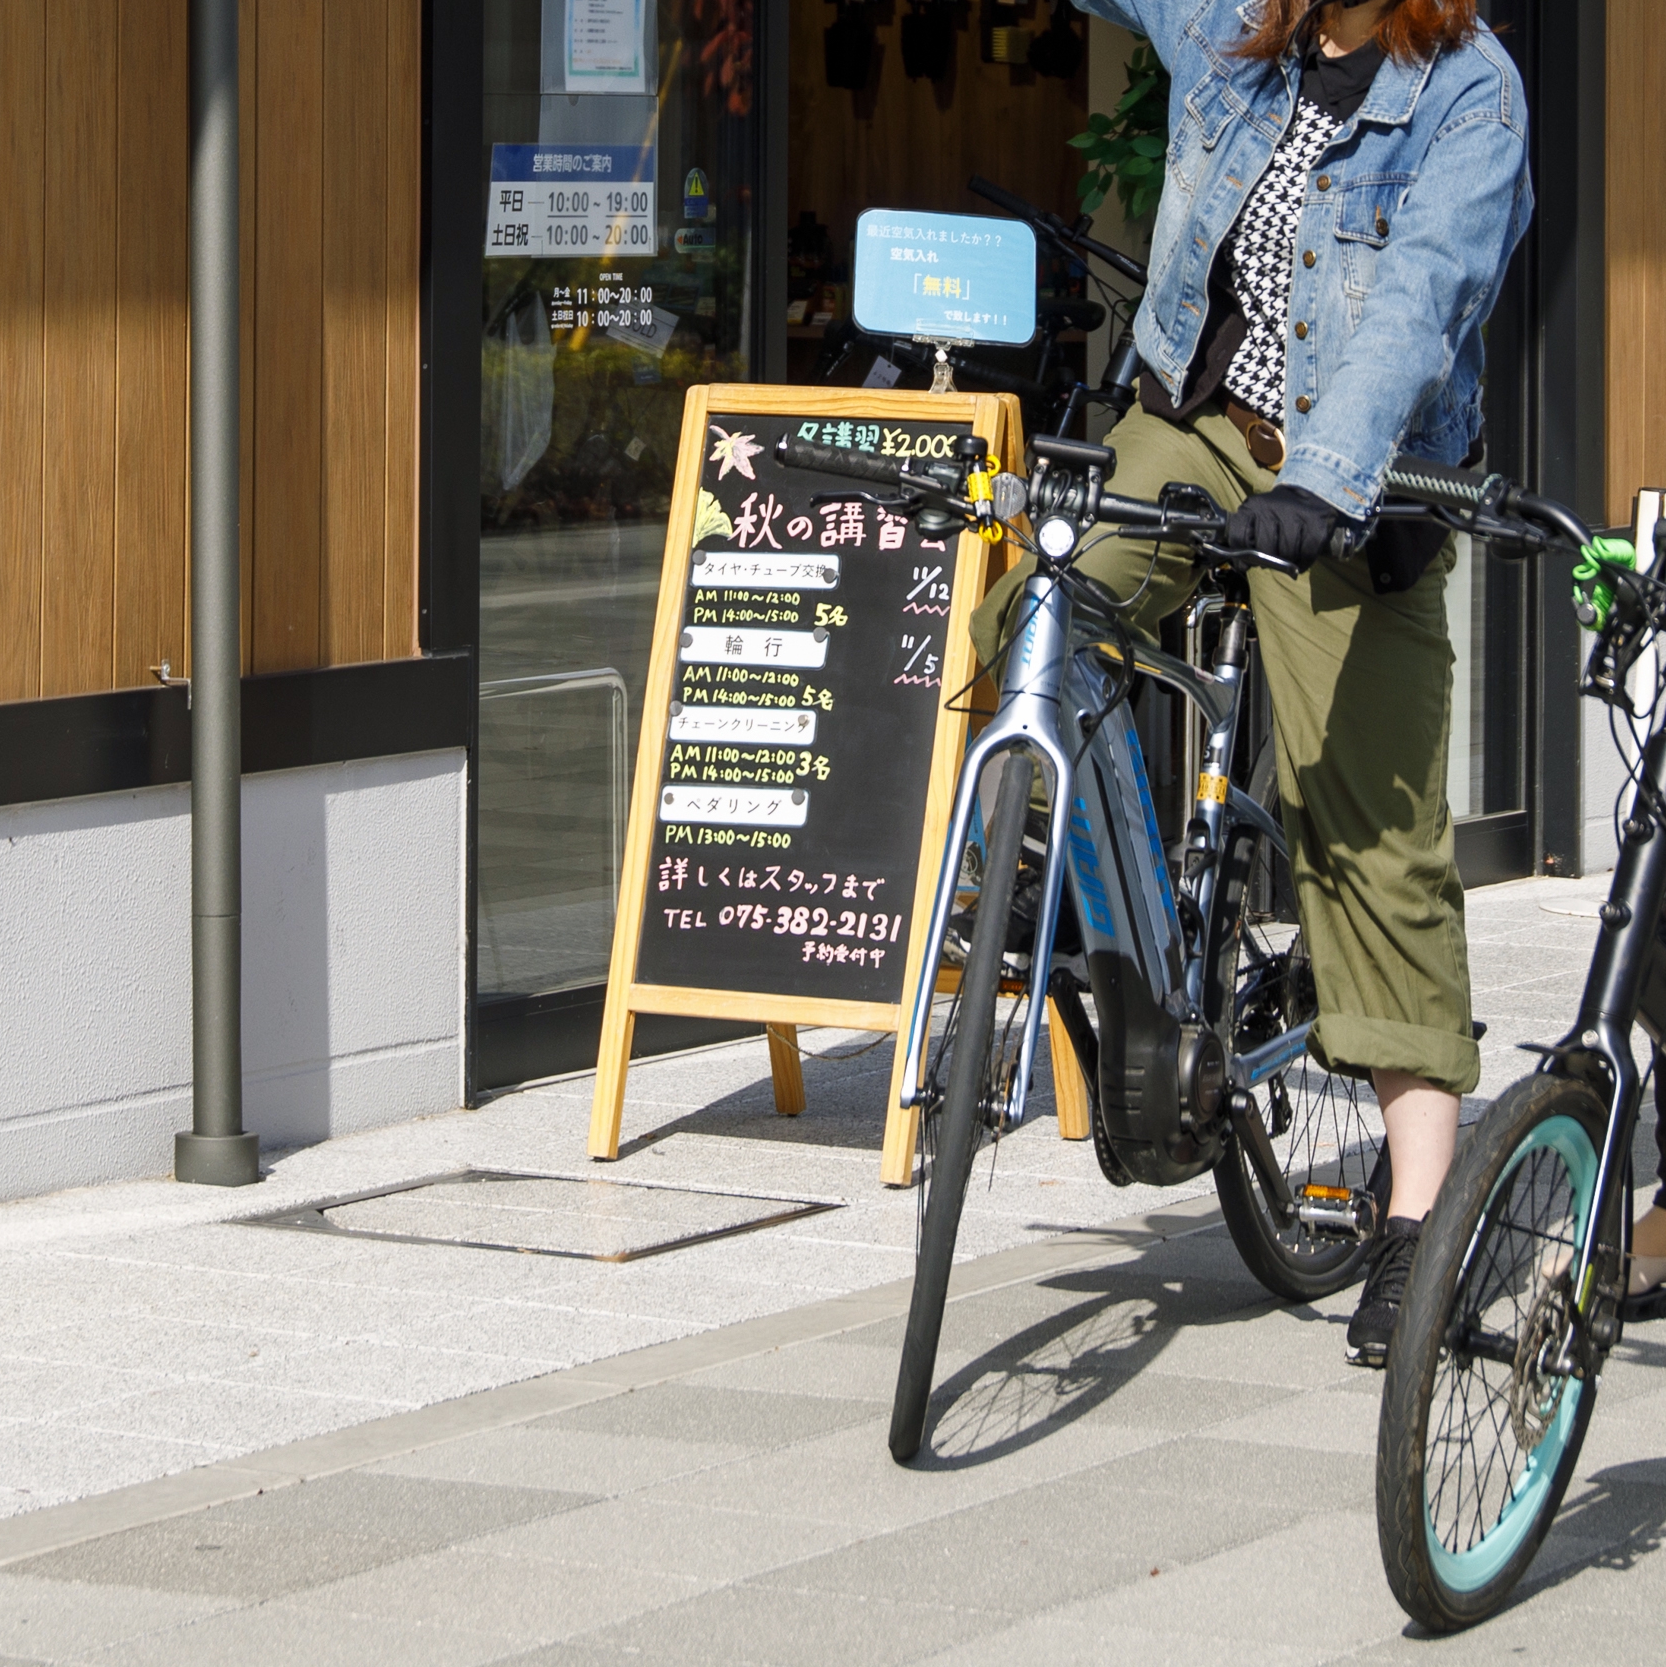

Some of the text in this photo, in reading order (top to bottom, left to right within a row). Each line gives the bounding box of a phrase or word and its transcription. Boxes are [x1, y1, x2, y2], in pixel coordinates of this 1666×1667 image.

[533, 154, 612, 173] 営業時間のご案内
[499, 190, 524, 212] 平日
[548, 191, 589, 212] 10:00
[606, 191, 648, 212] 19:00
[491, 223, 529, 246] 土日祝
[546, 225, 588, 245] 10:00
[604, 225, 648, 245] 20:00
[683, 234, 703, 245] Auto
[890, 247, 939, 263] 空気入れ
[599, 273, 611, 281] OPEN
[551, 310, 574, 321] 土日祝日
[732, 491, 946, 552] 秋の講習
[695, 589, 717, 604] AM
[693, 607, 717, 624] PM
[813, 602, 848, 627] 5名
[683, 665, 712, 683] AM
[683, 686, 709, 705] PM
[801, 684, 835, 712] 5名
[678, 716, 810, 735] チェーンクリーニング
[670, 744, 701, 762] AM
[670, 762, 697, 780] PM
[796, 751, 831, 781] 3名
[686, 796, 783, 816] ペダリング
[665, 824, 694, 844] PM
[658, 855, 885, 901] 詳しくはスタッフまで
[663, 903, 903, 943] TEL 075-382-2131
[802, 940, 886, 969] 予約受付中
